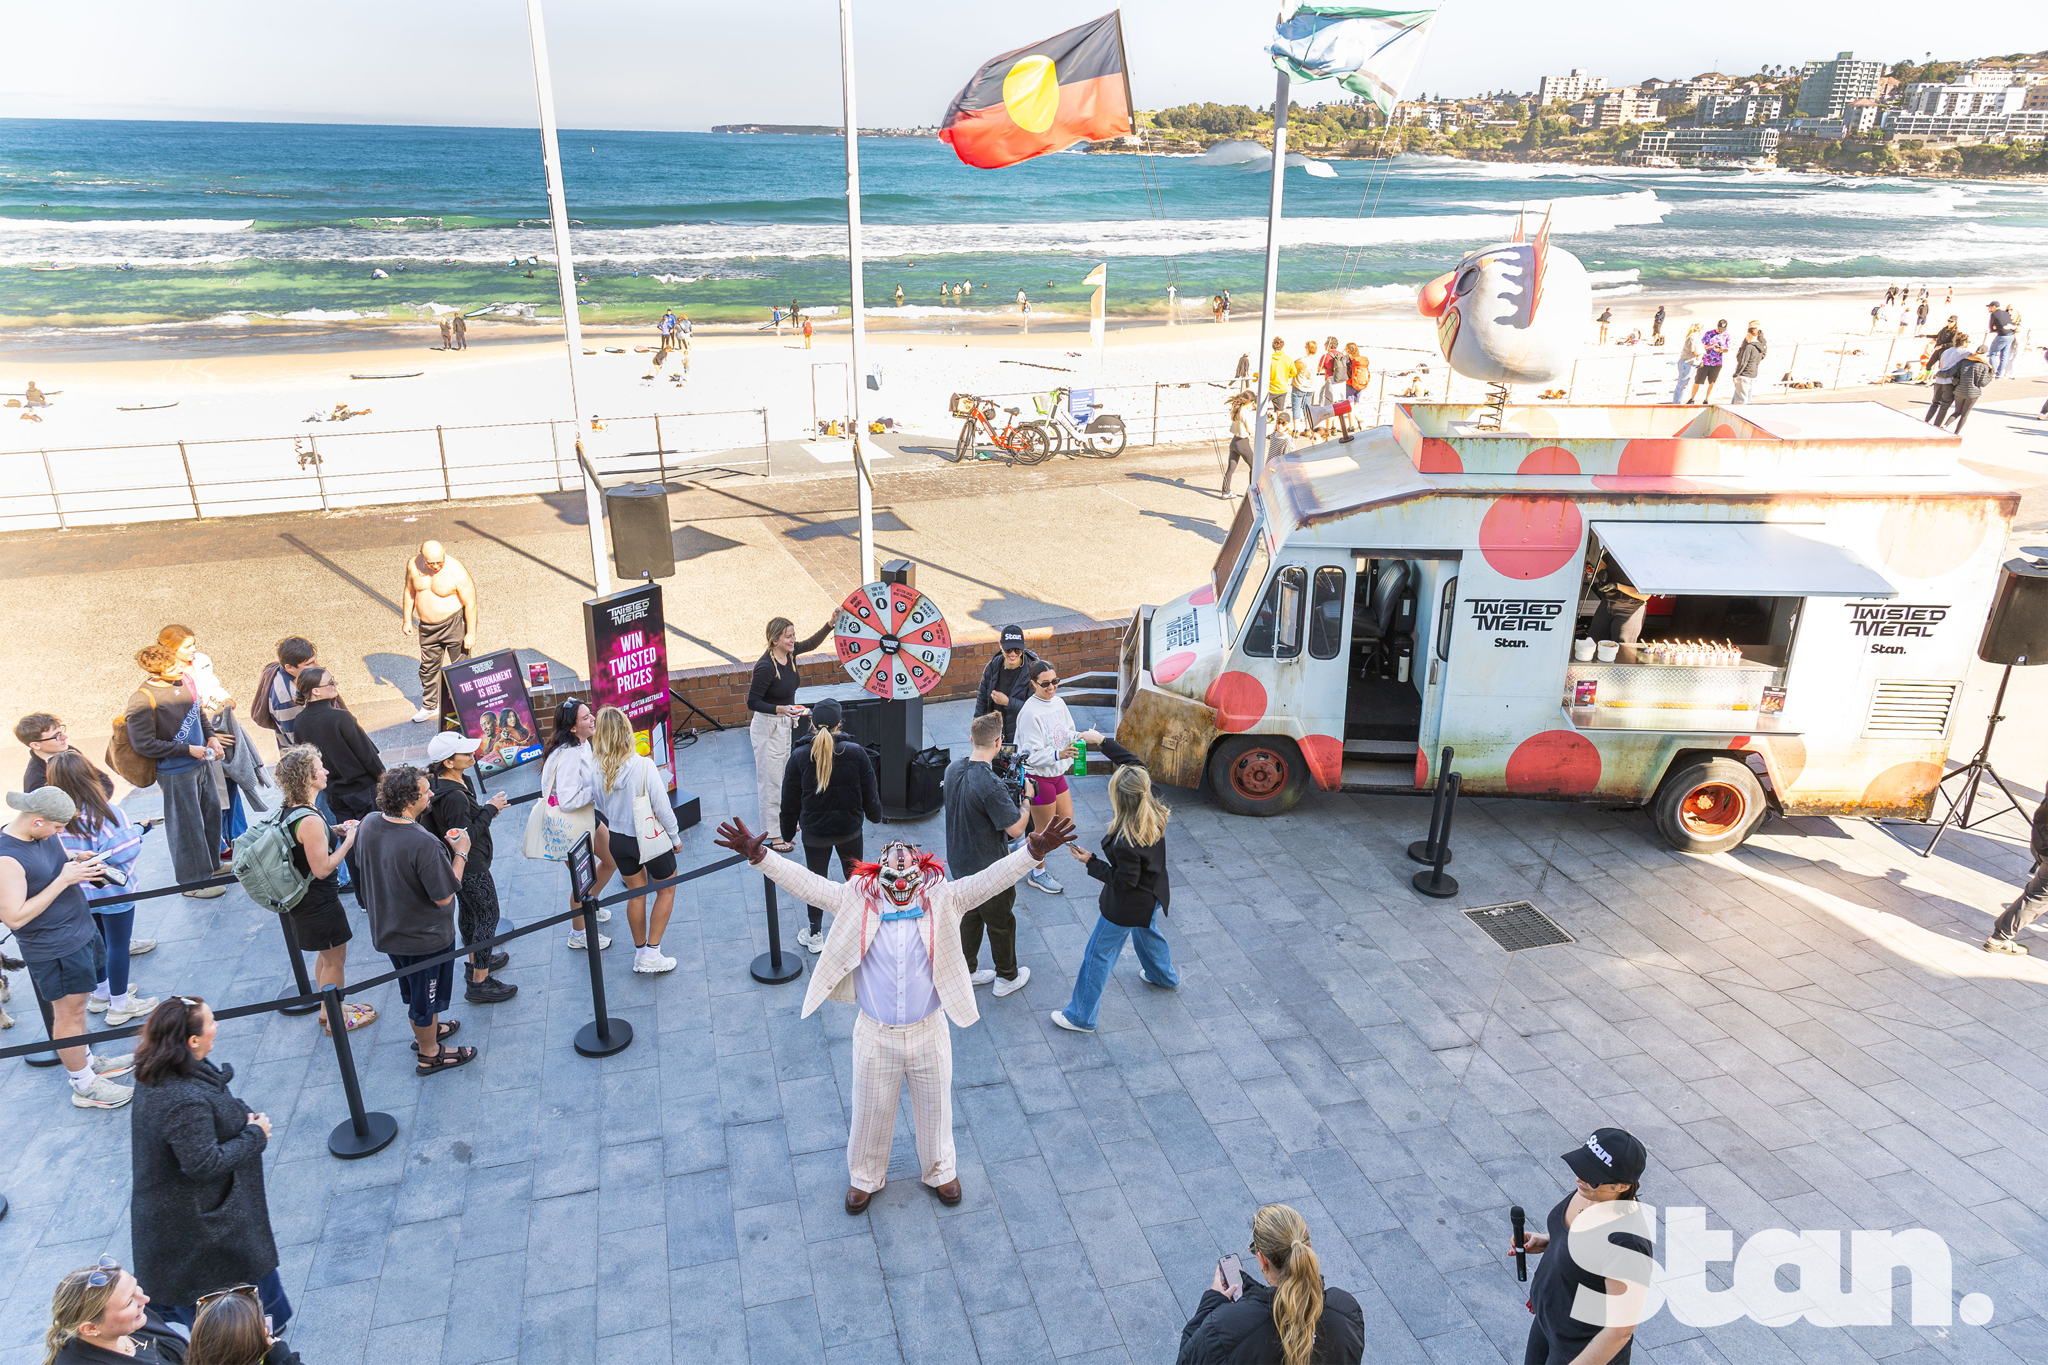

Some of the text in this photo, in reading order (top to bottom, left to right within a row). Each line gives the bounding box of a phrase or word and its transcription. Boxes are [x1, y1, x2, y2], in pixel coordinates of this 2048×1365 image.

[607, 598, 650, 617] TWISTED
[1464, 599, 1567, 616] TWISTED
[1844, 603, 1952, 621] TWISTED
[611, 609, 648, 626] METAL
[1471, 615, 1556, 631] METAL
[1850, 621, 1939, 637] METAL
[620, 631, 643, 653] WIN
[1494, 638, 1529, 648] Stan.
[1871, 643, 1907, 654] Stan.
[609, 646, 657, 676] TWISTED
[459, 669, 512, 693] THE TOURNAMENT
[617, 668, 653, 694] PRIZES
[478, 683, 502, 698] IS HERE
[1586, 1134, 1613, 1167] Stan.
